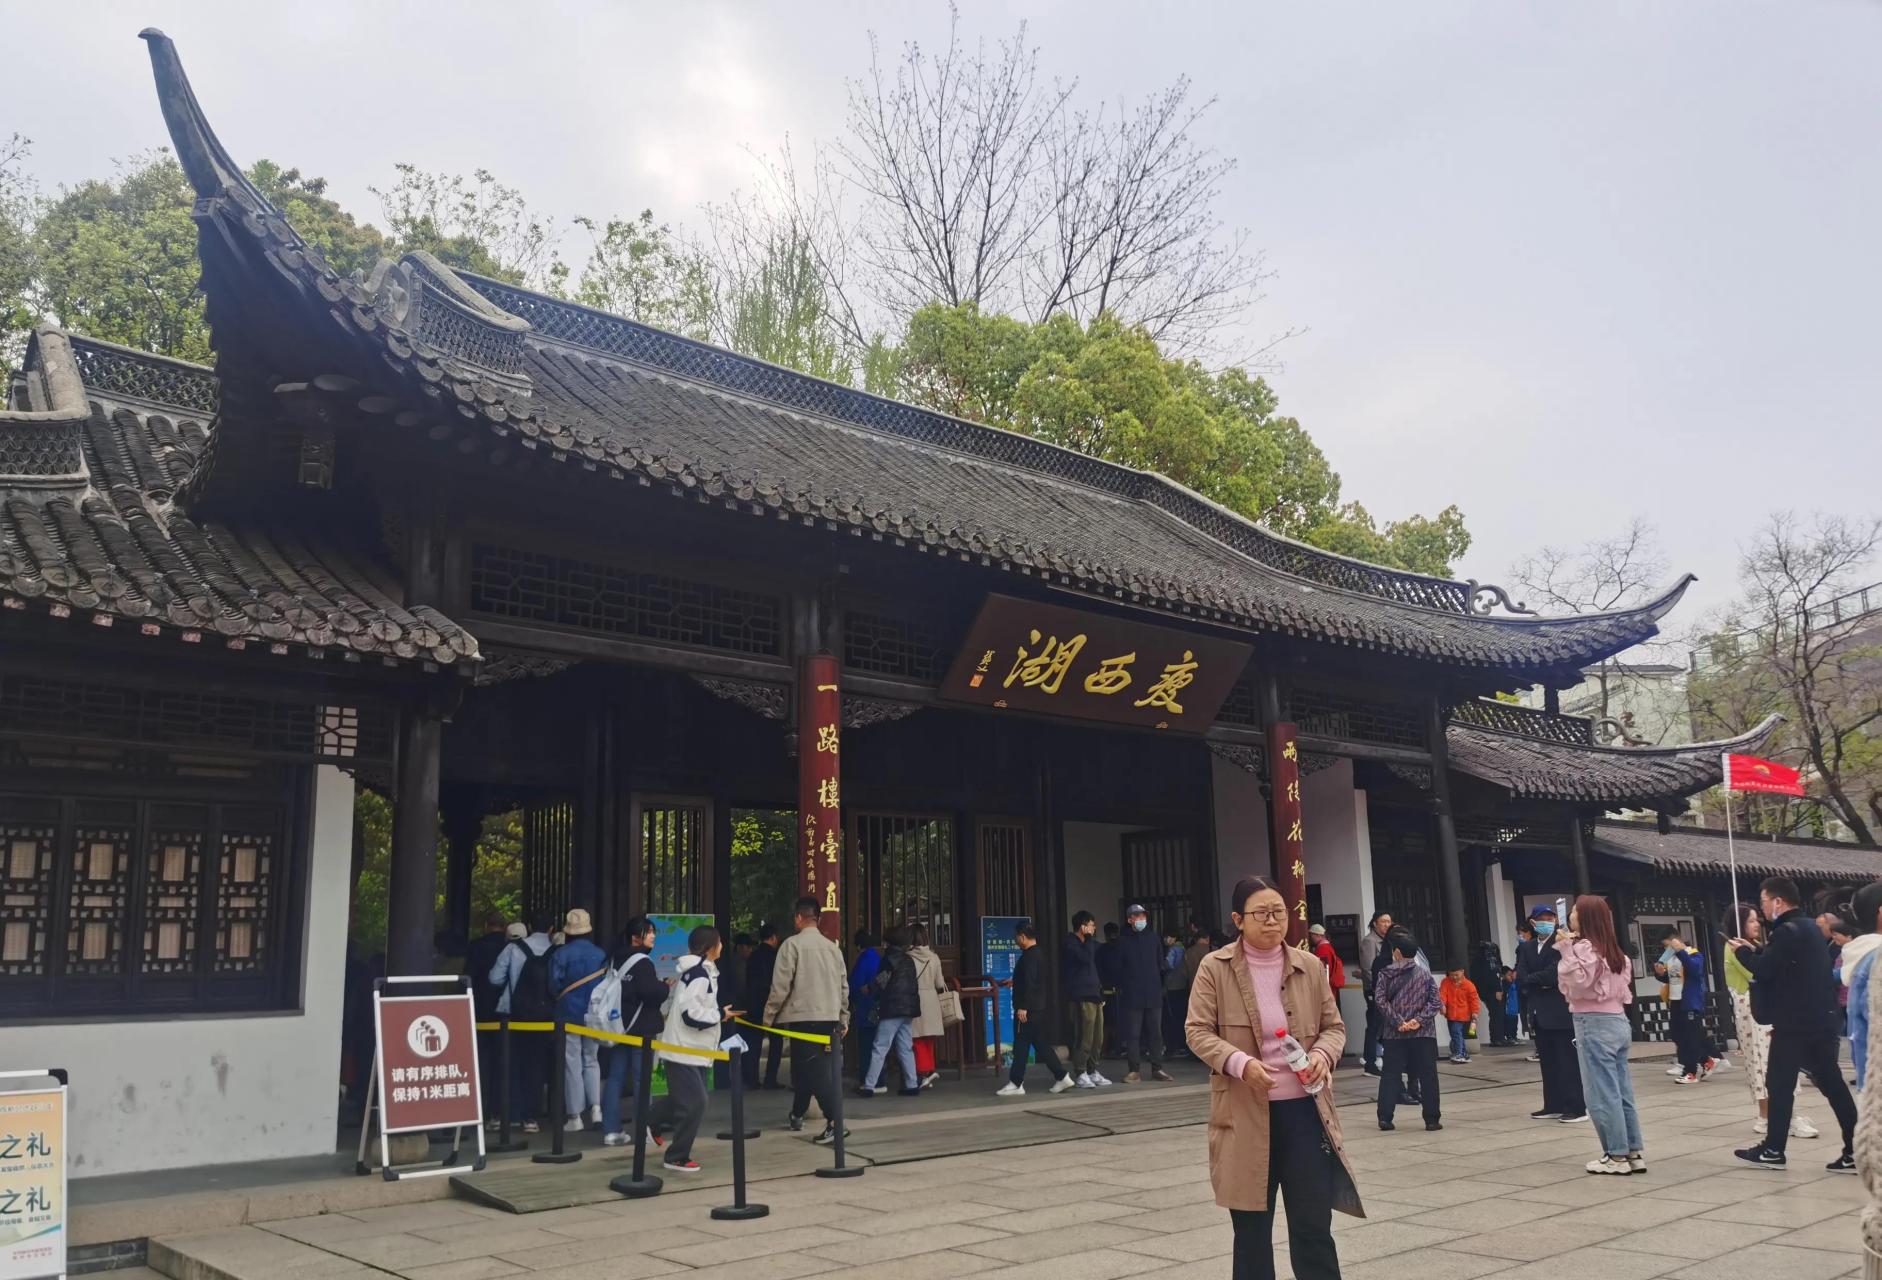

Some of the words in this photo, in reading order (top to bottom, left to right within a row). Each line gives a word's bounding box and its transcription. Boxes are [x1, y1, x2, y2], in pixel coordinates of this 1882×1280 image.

[1003, 629, 1199, 714] 瘦西湖
[393, 1083, 470, 1102] 保持1米距离
[0, 1131, 51, 1159] 之礼
[0, 1185, 51, 1214] 之礼
